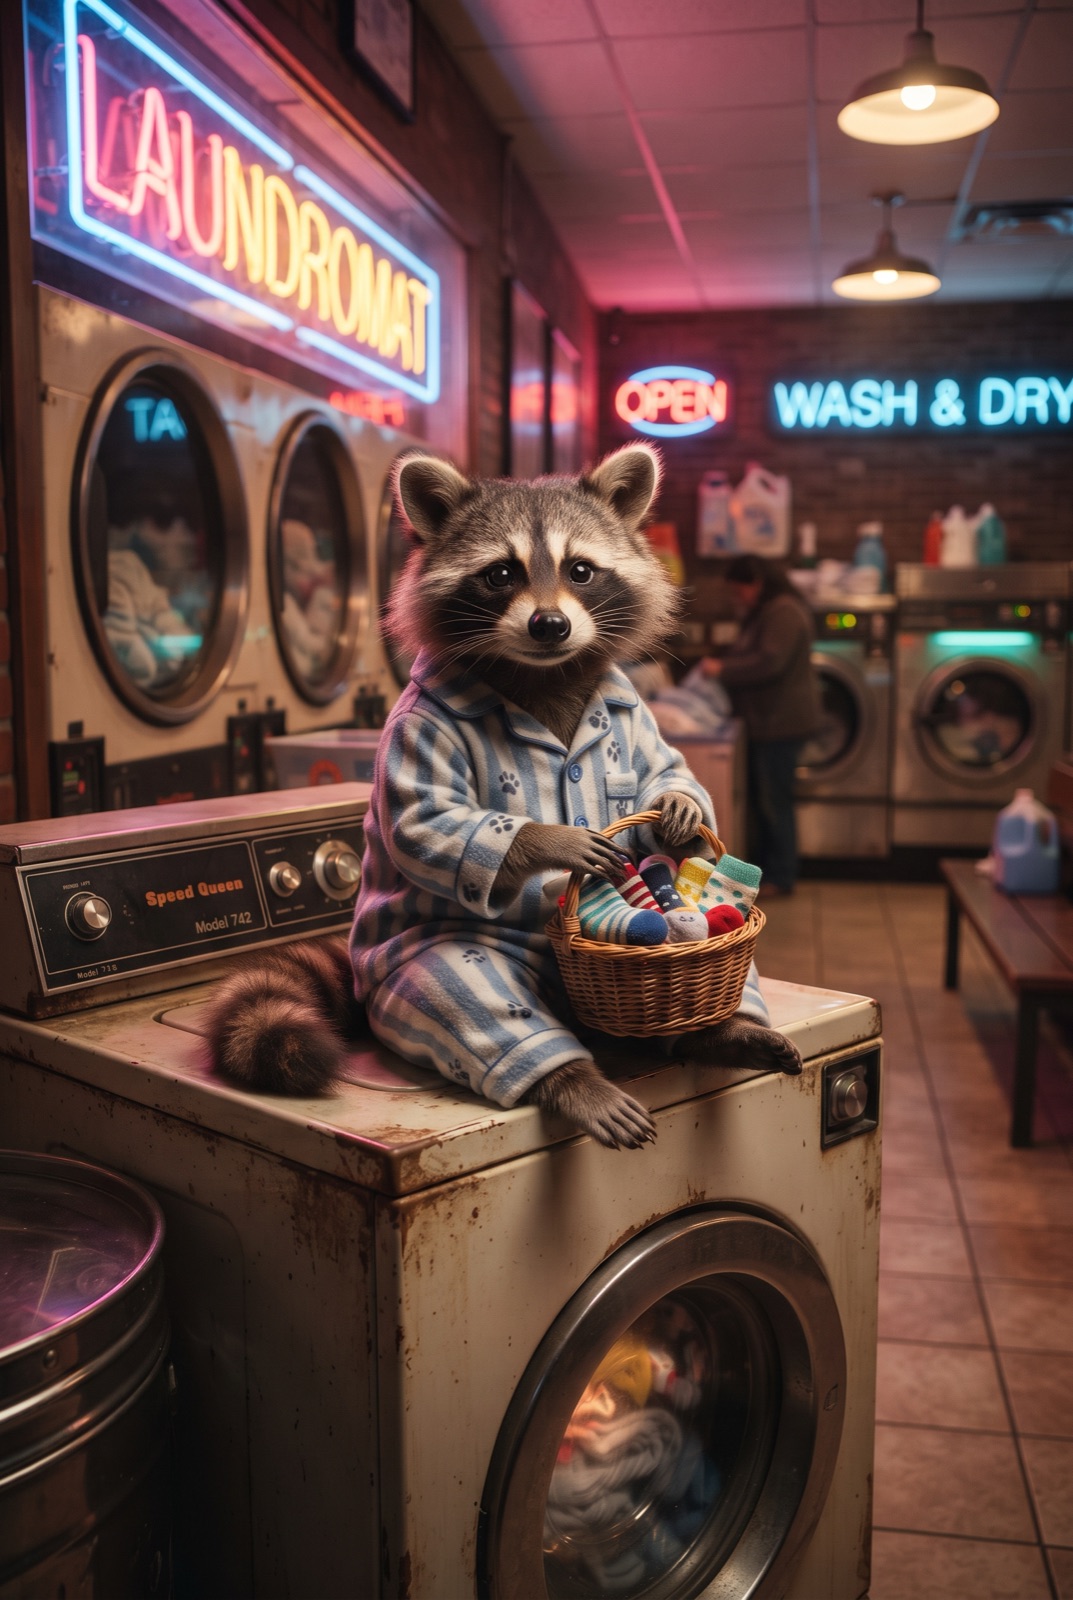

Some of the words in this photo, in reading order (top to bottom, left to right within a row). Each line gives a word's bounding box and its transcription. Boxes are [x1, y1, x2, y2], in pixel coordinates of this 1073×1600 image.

[78, 34, 432, 375] LAUNDROMAT
[615, 379, 727, 424] OPEN
[774, 379, 918, 428] WASH
[929, 379, 966, 426] &
[979, 376, 1073, 425] DRY
[145, 885, 195, 908] Speed
[197, 879, 243, 896] Queen
[195, 915, 229, 934] Model
[230, 911, 252, 927] 742
[77, 968, 98, 979] Model
